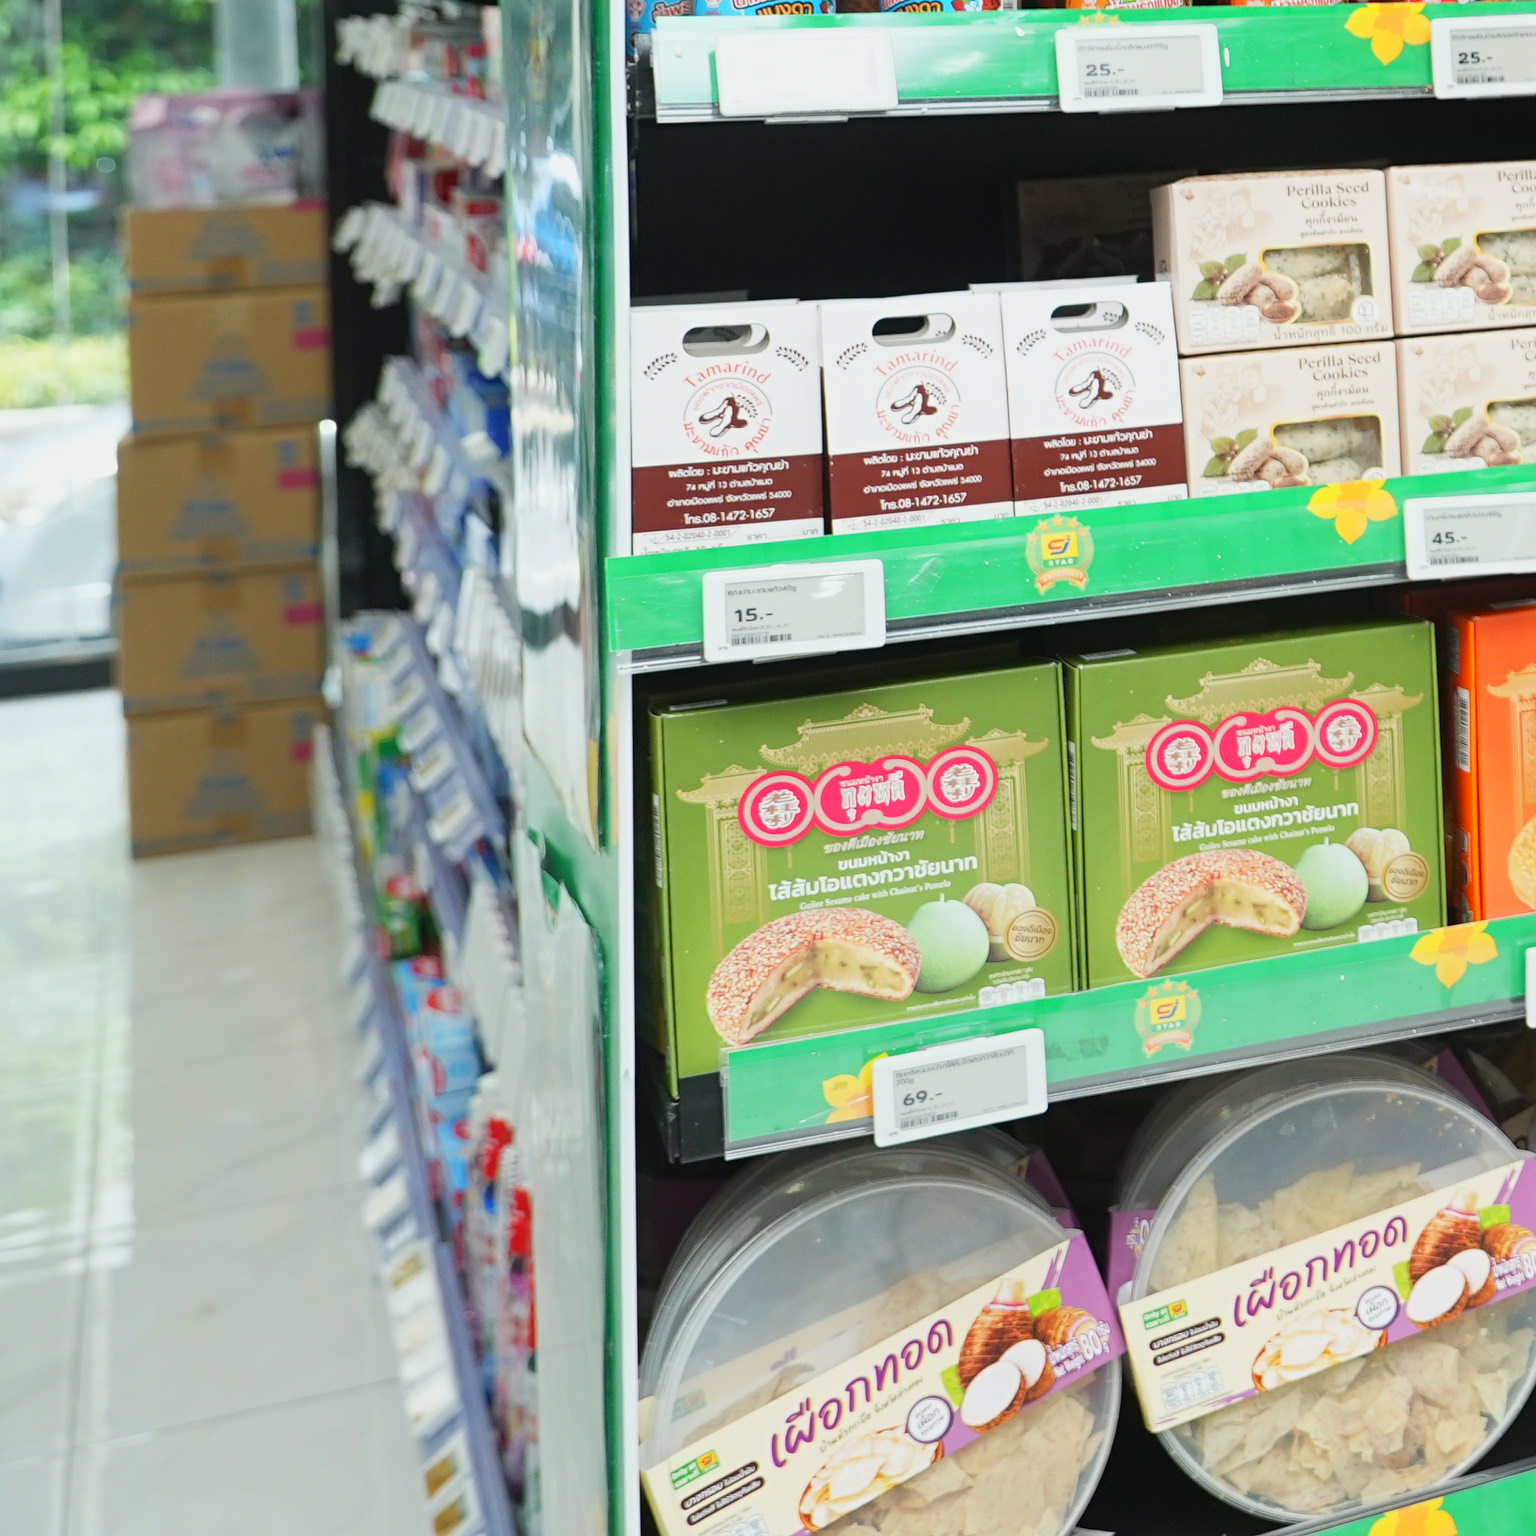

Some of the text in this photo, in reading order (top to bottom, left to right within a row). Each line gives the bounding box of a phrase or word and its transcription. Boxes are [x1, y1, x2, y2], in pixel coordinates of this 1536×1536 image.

[1457, 51, 1494, 65] 25.-
[1085, 62, 1126, 77] 25.-
[1285, 182, 1370, 198] Perilla Seed
[1300, 195, 1358, 209] Cookies
[1339, 323, 1363, 336] 100
[1366, 320, 1390, 334] กรัม
[1052, 334, 1134, 363] Tamarind
[874, 349, 960, 378] Tamarind
[1298, 352, 1382, 370] Perilla Seed
[682, 360, 773, 388] Tamarind
[1312, 366, 1370, 382] Cookies
[683, 417, 774, 459] มะขามแก้ว คุณย่า
[1431, 530, 1469, 546] 45.-
[1047, 557, 1076, 567] STAR
[732, 606, 775, 624] 15.-
[1232, 795, 1299, 816] ขนมหน้างา
[1171, 800, 1361, 844] ไส้ส้มโอแตงกวาชัยนาท
[1263, 831, 1280, 843] with
[837, 849, 911, 872] ขนมหน้างา
[768, 854, 978, 903] ไส้ส้มโอแตงกวาชัยนาท
[853, 891, 871, 904] cake
[871, 888, 889, 901] with
[923, 878, 953, 894] Pomelo
[902, 1089, 944, 1108] 69.-
[1232, 1215, 1409, 1329] เผือกทอด
[1078, 1328, 1102, 1361] 80
[769, 1317, 956, 1469] เผือกทอด
